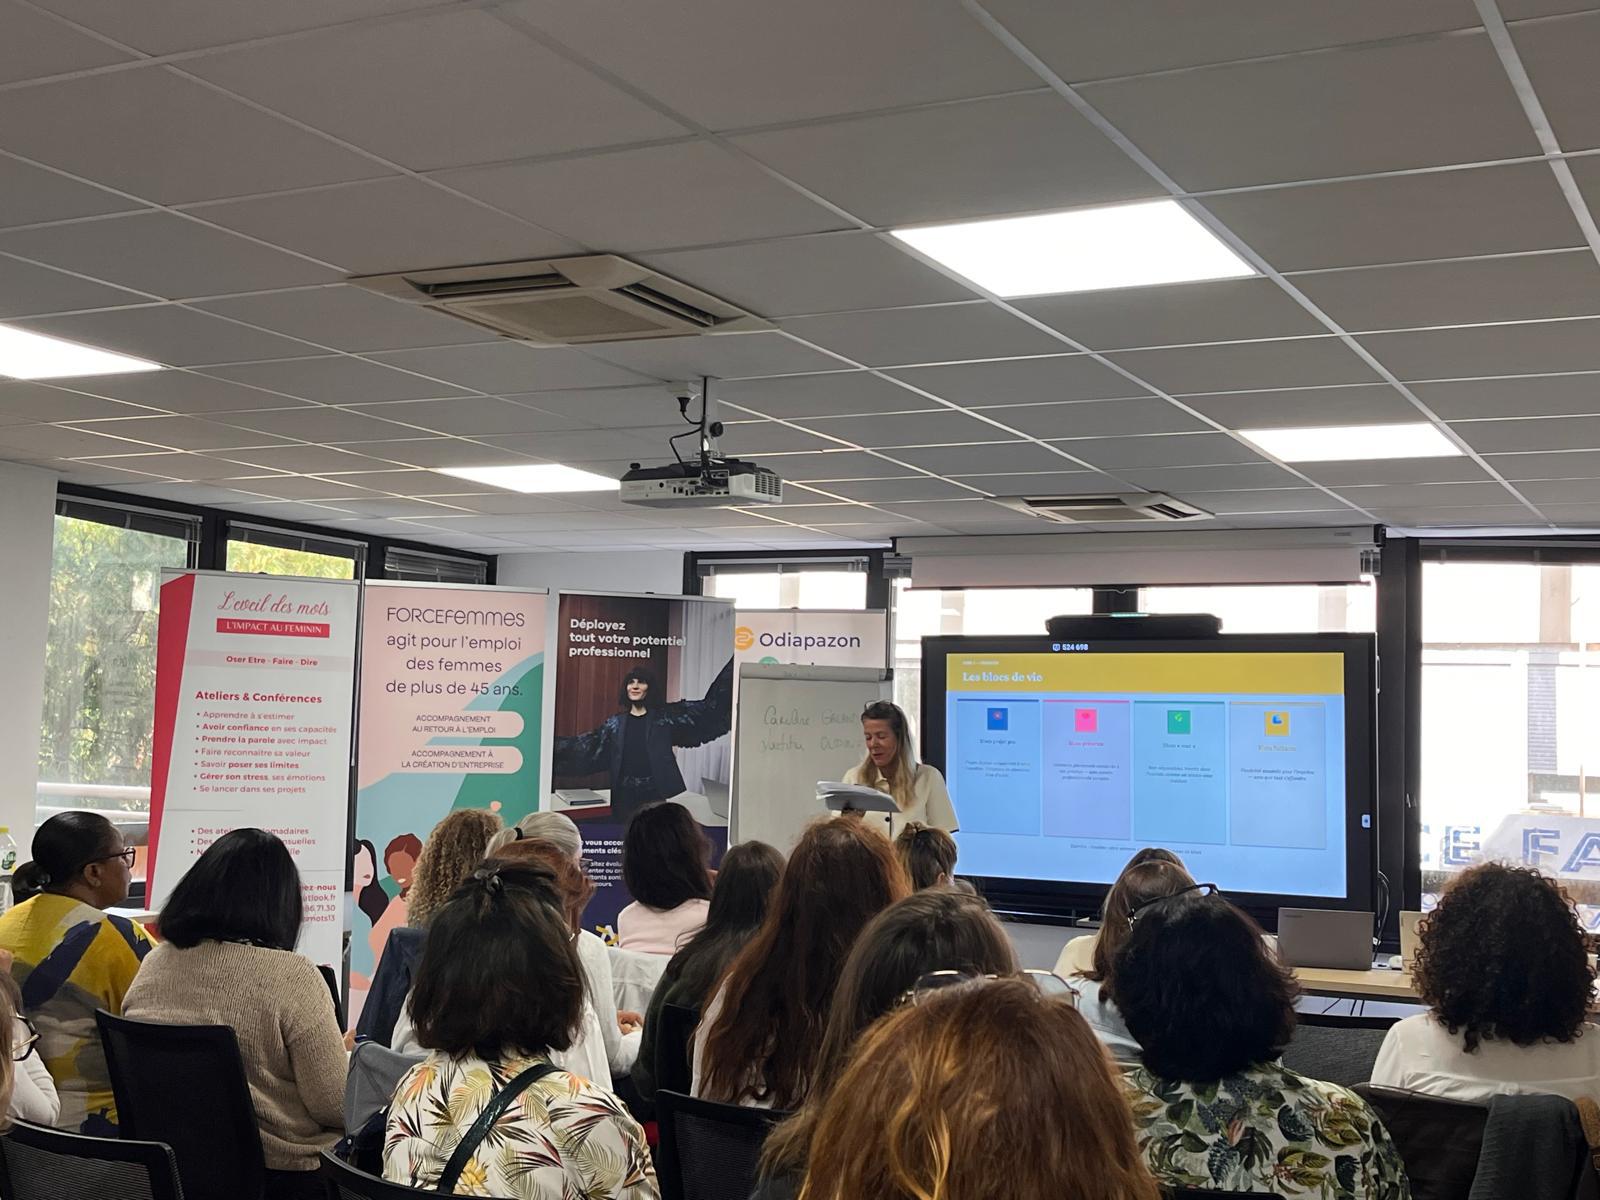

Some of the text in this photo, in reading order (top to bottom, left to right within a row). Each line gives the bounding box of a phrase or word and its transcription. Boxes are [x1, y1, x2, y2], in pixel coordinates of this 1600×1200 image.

[270, 594, 293, 613] des
[296, 600, 330, 616] mots
[226, 621, 321, 633] L'IMPACT AU FEMININ
[570, 618, 626, 631] Déployez
[386, 633, 521, 652] agit pour l'emploi
[569, 632, 687, 647] tout votre potentiel
[759, 632, 861, 650] Odiapazon
[569, 646, 651, 658] professionnel
[226, 656, 246, 664] Oser
[248, 656, 266, 664] Etre
[406, 657, 502, 672] des femmes
[962, 672, 1043, 682] Les blocs de vie
[385, 680, 524, 696] de plus de 45 ans.
[195, 691, 323, 704] Ateliers & Conférences
[203, 711, 248, 721] Apprendre
[416, 714, 491, 722] ACCOMPAGNEMENT
[202, 723, 225, 731] Avoir
[227, 724, 270, 732] confiance
[298, 726, 337, 735] capacités
[462, 726, 496, 734] L'EMPLOI
[202, 735, 236, 744] Prendre
[238, 736, 246, 744] la
[248, 737, 276, 745] parole
[200, 760, 226, 768] Savoir
[228, 762, 253, 770] poser
[270, 761, 300, 769] limites
[412, 760, 450, 769] CRÉATION
[200, 772, 224, 781] Gérer
[286, 774, 326, 782] émotions
[276, 786, 306, 795] projets
